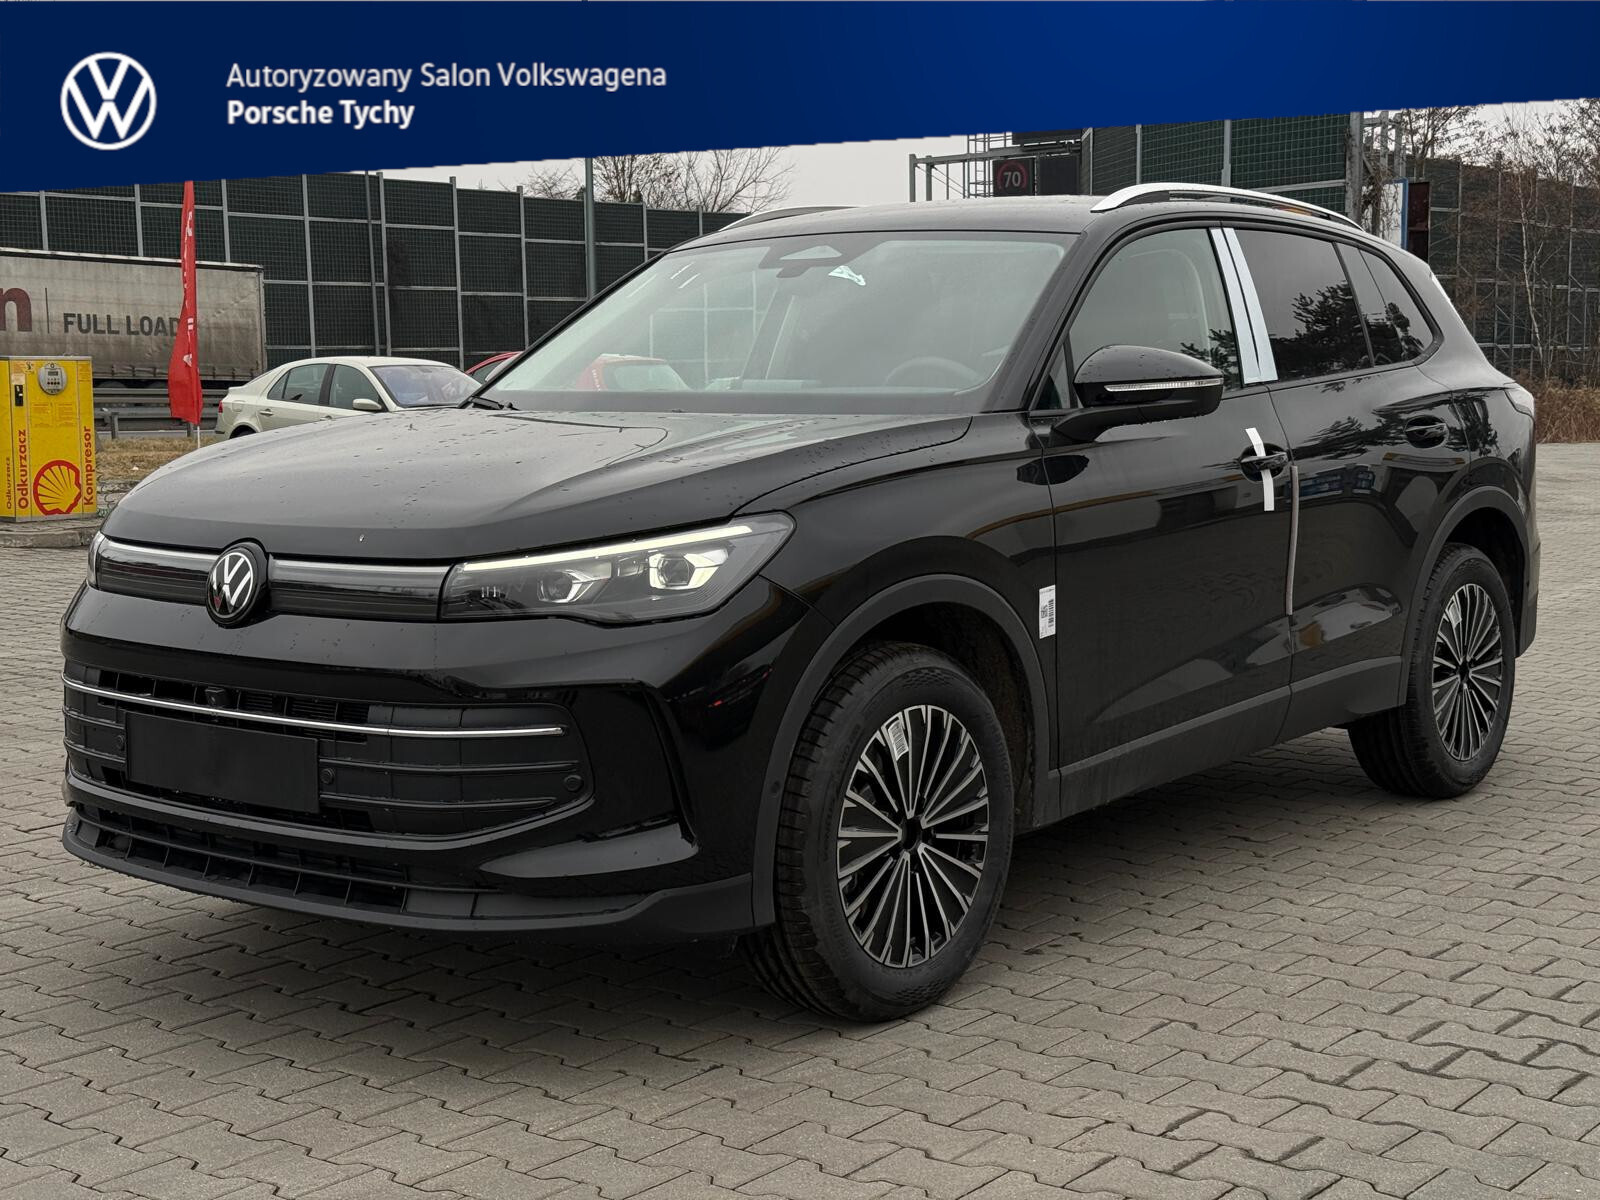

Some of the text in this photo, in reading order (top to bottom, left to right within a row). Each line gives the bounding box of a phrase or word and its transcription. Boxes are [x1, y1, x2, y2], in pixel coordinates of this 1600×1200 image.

[1003, 171, 1021, 188] 70
[63, 312, 120, 335] FULL
[17, 429, 29, 510] Odkurzacz
[83, 426, 95, 506] Kompresor
